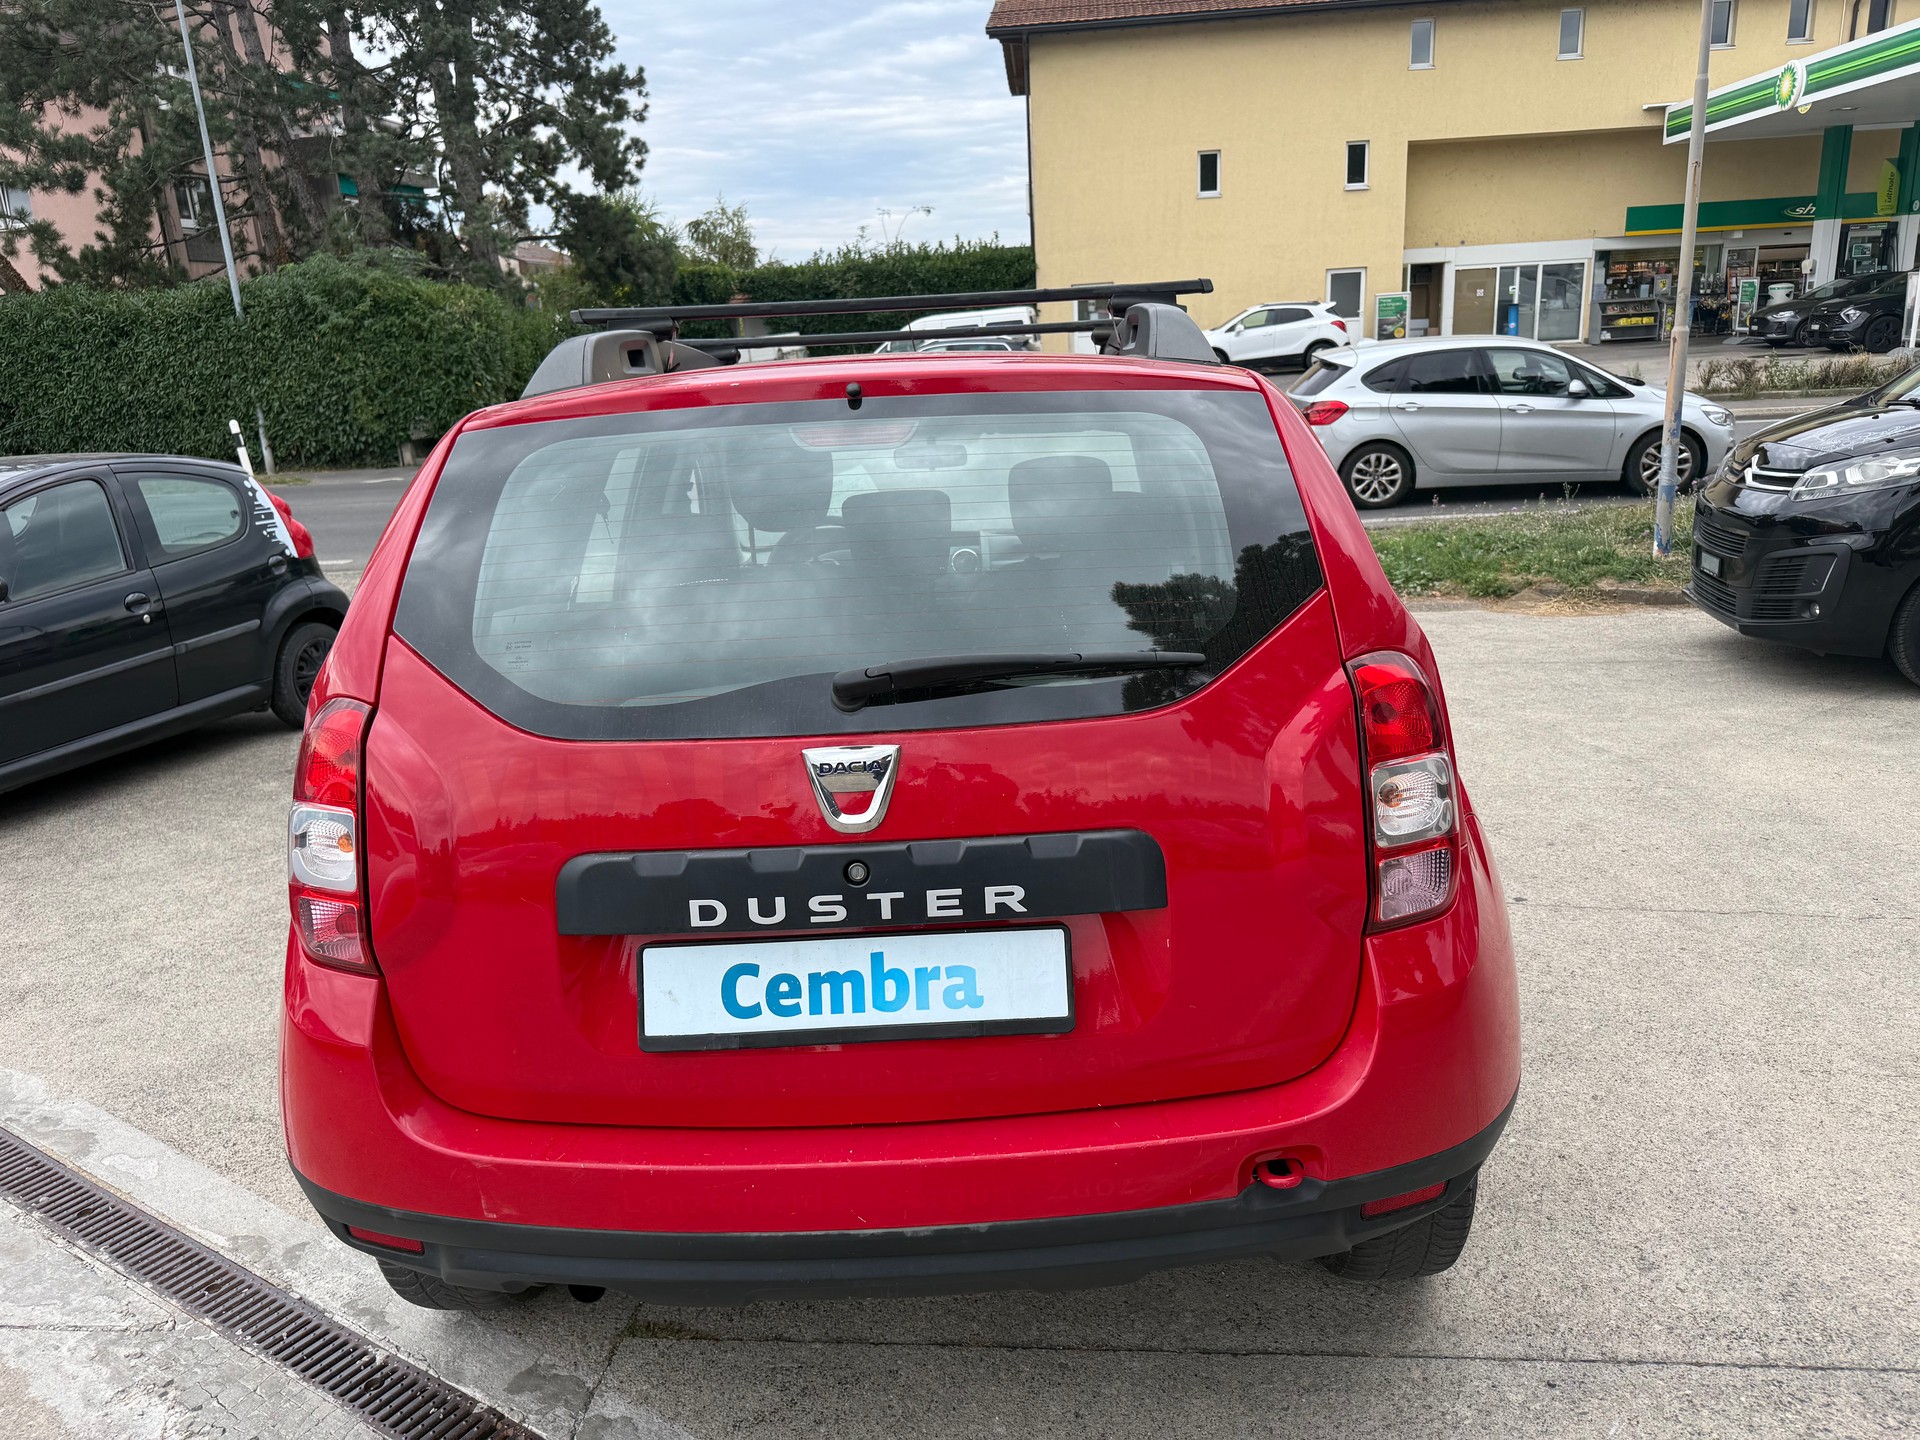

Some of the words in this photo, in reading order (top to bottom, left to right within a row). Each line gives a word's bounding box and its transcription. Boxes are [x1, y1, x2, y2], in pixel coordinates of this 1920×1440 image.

[1795, 203, 1816, 214] sh
[819, 760, 884, 774] DACIA
[688, 885, 1028, 927] DUSTER
[720, 951, 985, 1020] Cembra
